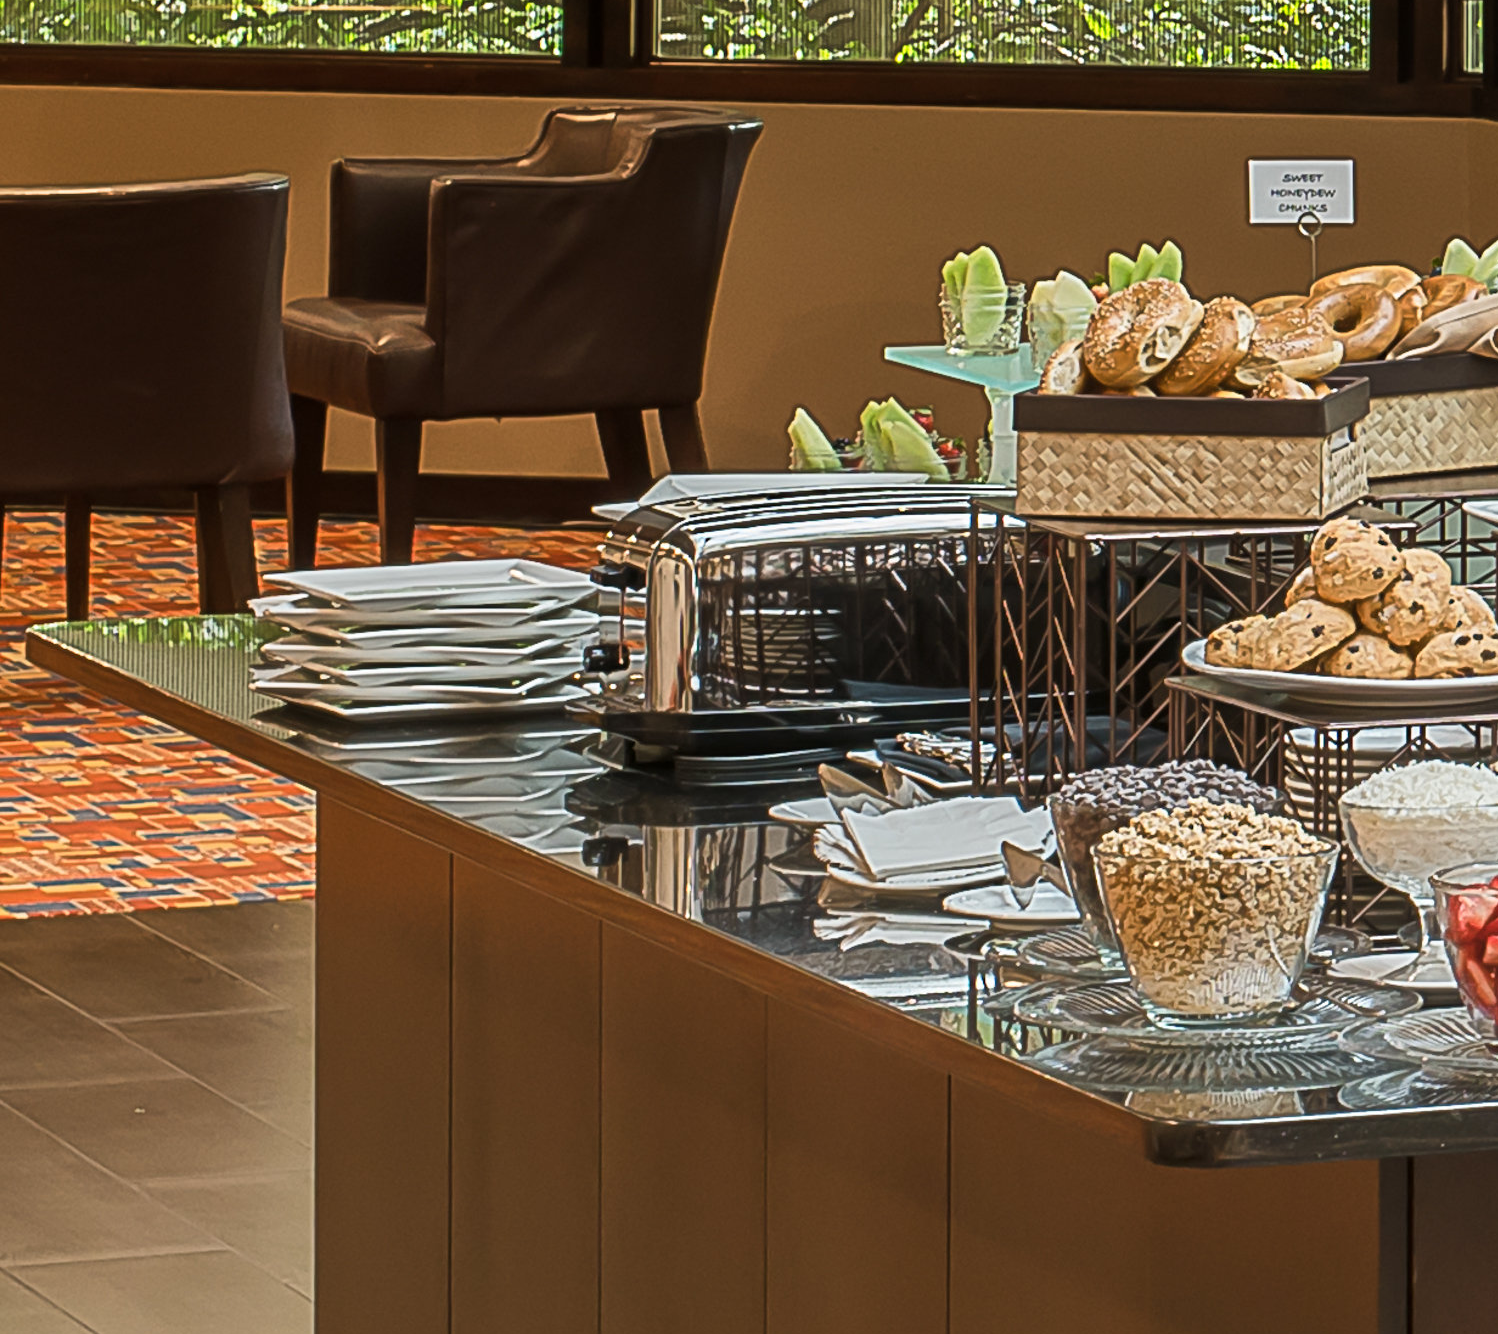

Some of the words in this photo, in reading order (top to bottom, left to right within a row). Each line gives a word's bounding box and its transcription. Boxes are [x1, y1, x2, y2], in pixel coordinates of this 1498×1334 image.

[1282, 173, 1323, 183] SWEET
[1270, 188, 1337, 201] HONEYDEW
[1278, 203, 1328, 213] CHUNKS
